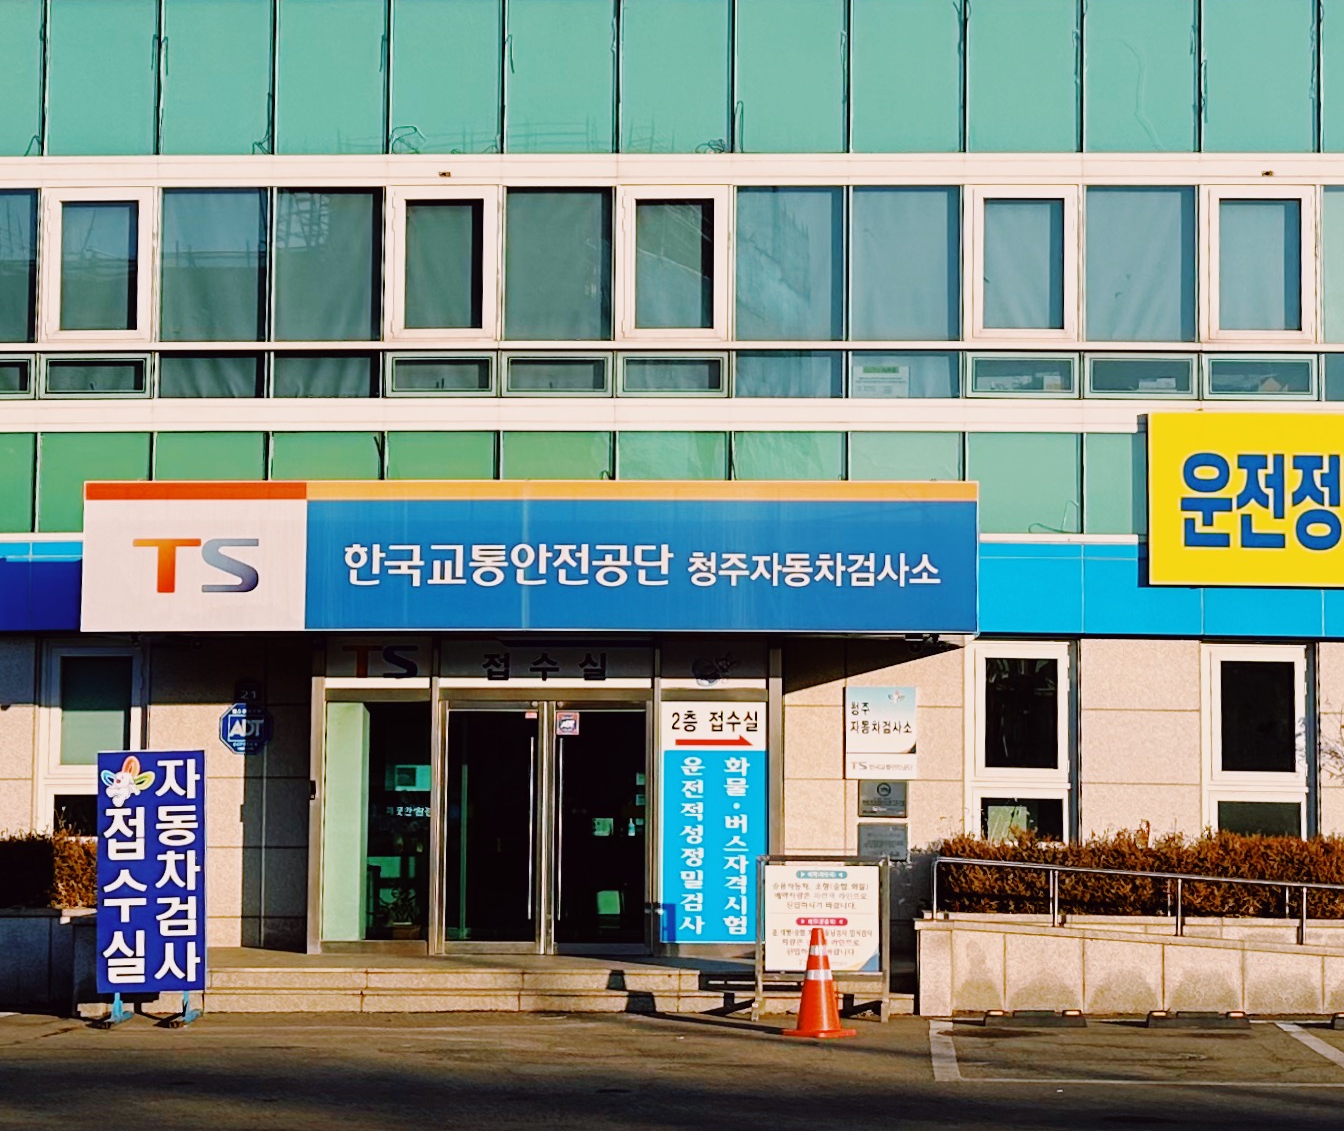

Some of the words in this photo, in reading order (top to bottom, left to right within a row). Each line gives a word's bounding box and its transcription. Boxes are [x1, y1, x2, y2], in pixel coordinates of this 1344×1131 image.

[132, 538, 259, 594] TS
[343, 542, 672, 589] 한국교통안전공단
[686, 550, 943, 589] 청주자동차검사소
[343, 645, 418, 679] TS
[481, 651, 609, 682] 접수실
[672, 711, 698, 732] 2층
[708, 710, 758, 732] 접수실
[851, 701, 870, 716] 청주
[229, 719, 265, 738] ADT
[850, 720, 913, 734] 자동차검사소
[679, 756, 706, 935] 운전적성정밀검사
[154, 758, 201, 983] 자동차검사
[102, 806, 148, 984] 접수실
